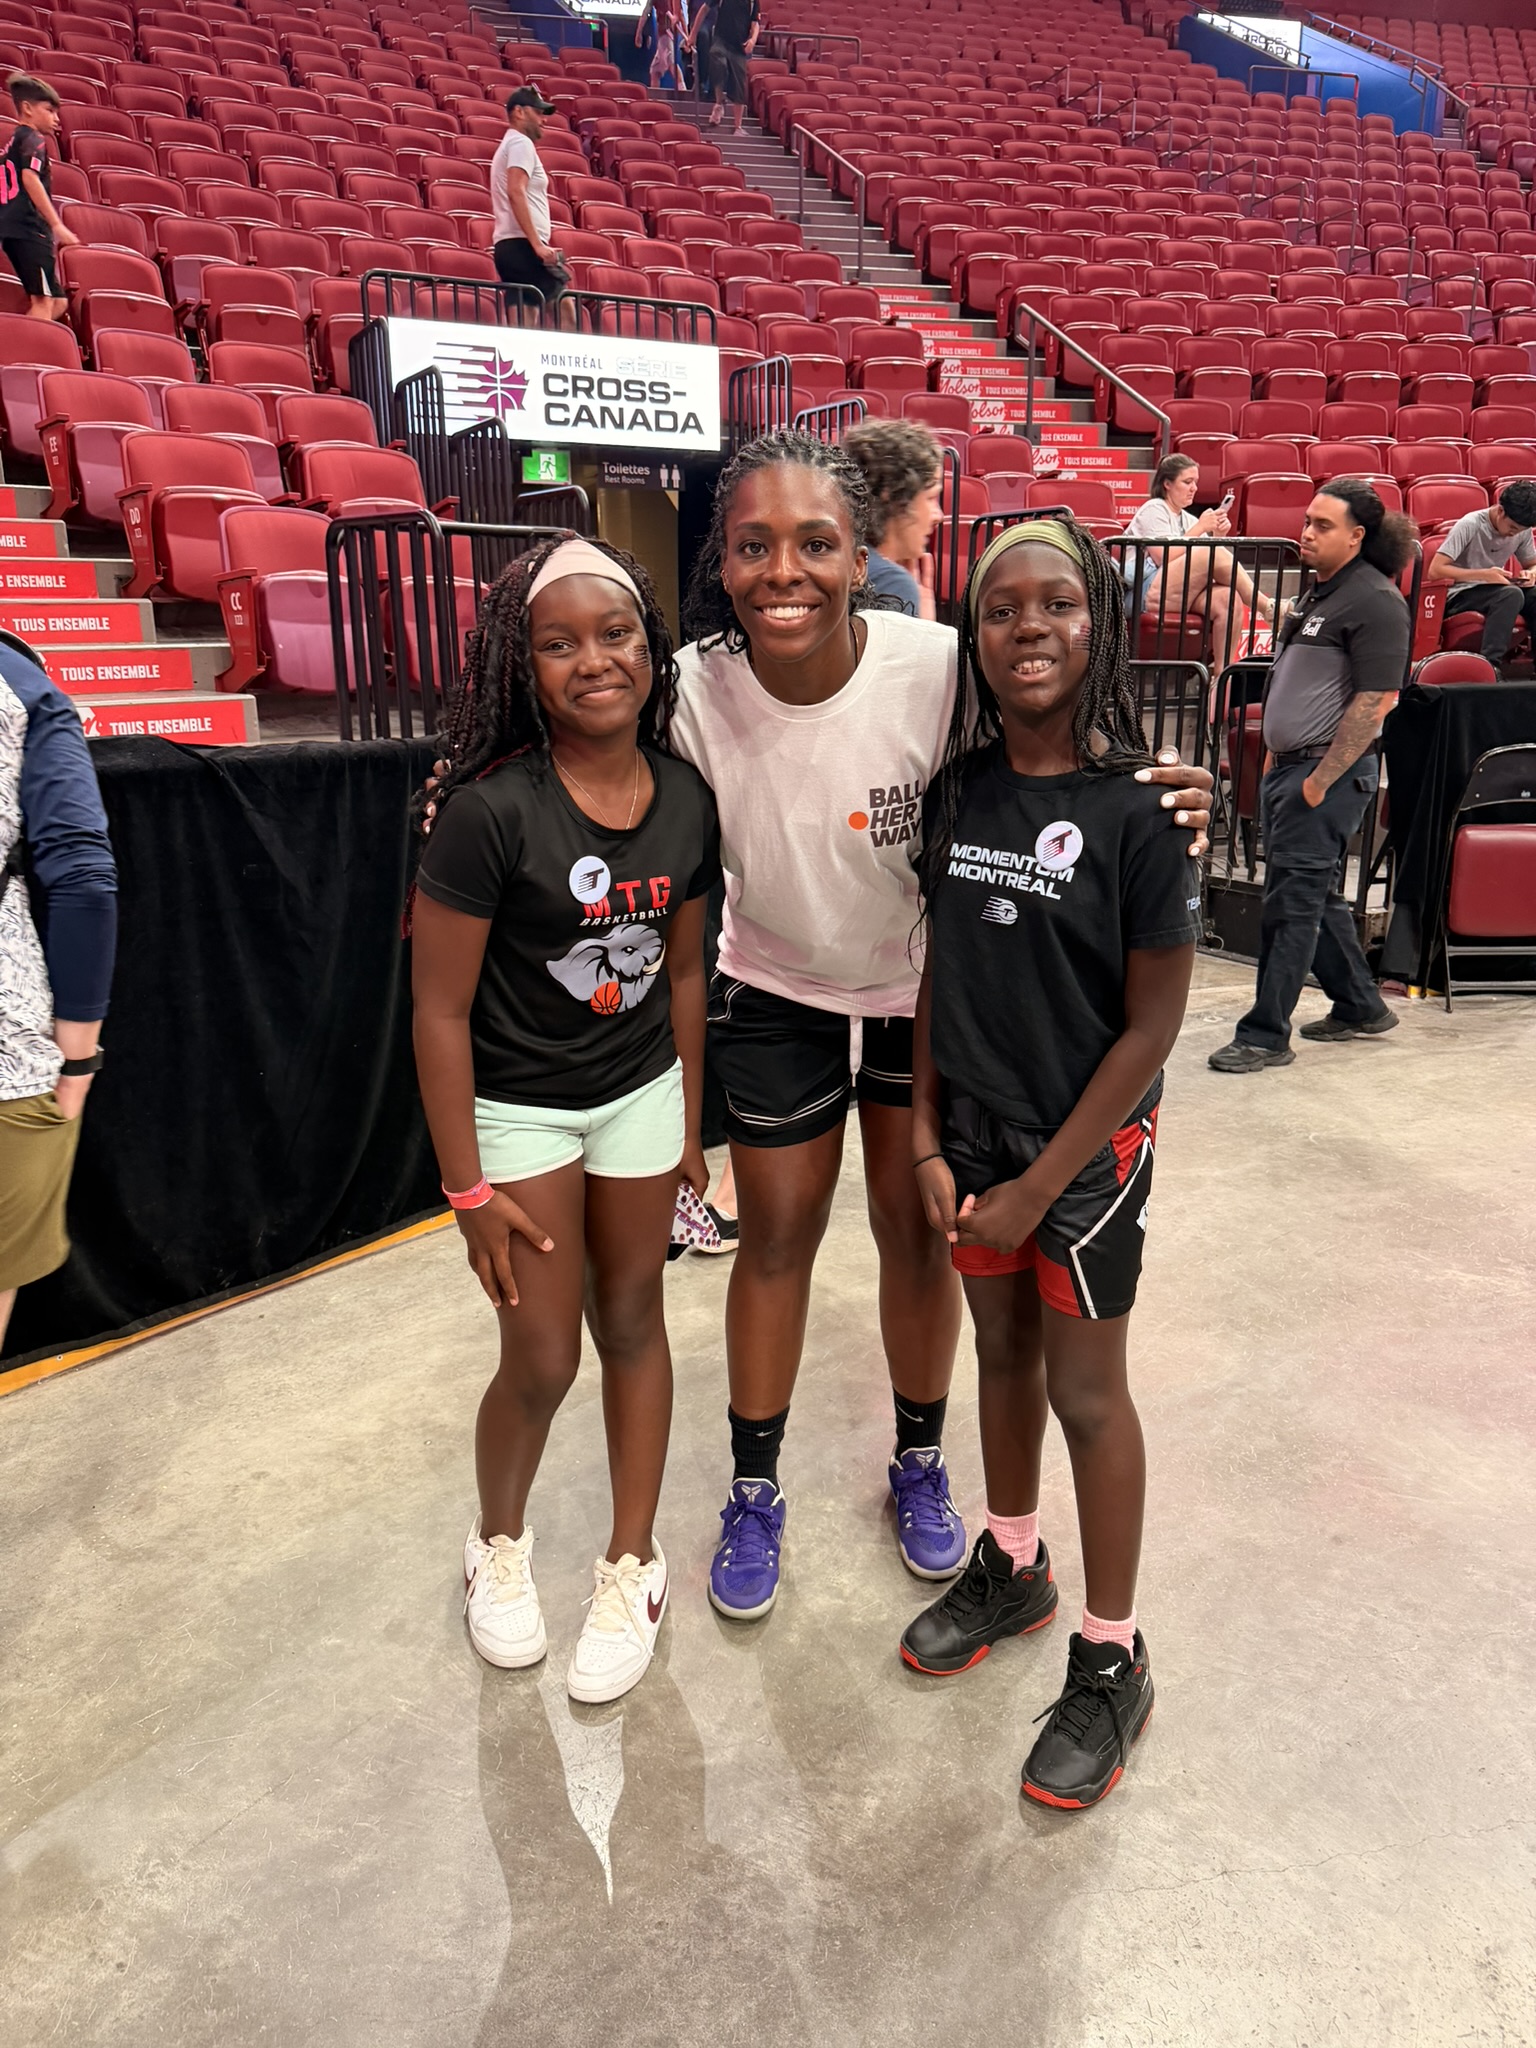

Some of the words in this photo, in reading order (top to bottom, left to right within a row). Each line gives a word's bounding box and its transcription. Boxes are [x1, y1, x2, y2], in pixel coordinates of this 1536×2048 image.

[541, 354, 603, 370] MONTRÉAL
[543, 373, 686, 404] CROSS-
[1001, 387, 1028, 395] ENSEMBL
[544, 402, 704, 435] CANADA
[1053, 434, 1083, 442] ENSEMBLE
[602, 462, 650, 475] Toilettes
[1064, 457, 1080, 466] TOUS
[1081, 457, 1112, 466] ENSEMBLE
[604, 475, 620, 484] Rest
[621, 475, 645, 484] Rooms
[6, 575, 67, 588] ENSEMBLE
[230, 592, 243, 611] CC
[1424, 595, 1436, 609] CC
[12, 617, 46, 631] TOUS
[48, 616, 110, 631] ENSEMBLE
[1302, 622, 1322, 637] Bell
[60, 667, 95, 682] TOUS
[97, 664, 160, 681] ENSEMBLE
[109, 721, 145, 736] TOUS
[147, 716, 213, 736] ENSEMBLE
[869, 780, 922, 808] BALL
[870, 802, 917, 830] HER
[870, 817, 922, 848] WAY
[947, 861, 1061, 900] MONTRÉAL
[580, 907, 668, 926] BASKETBALL
